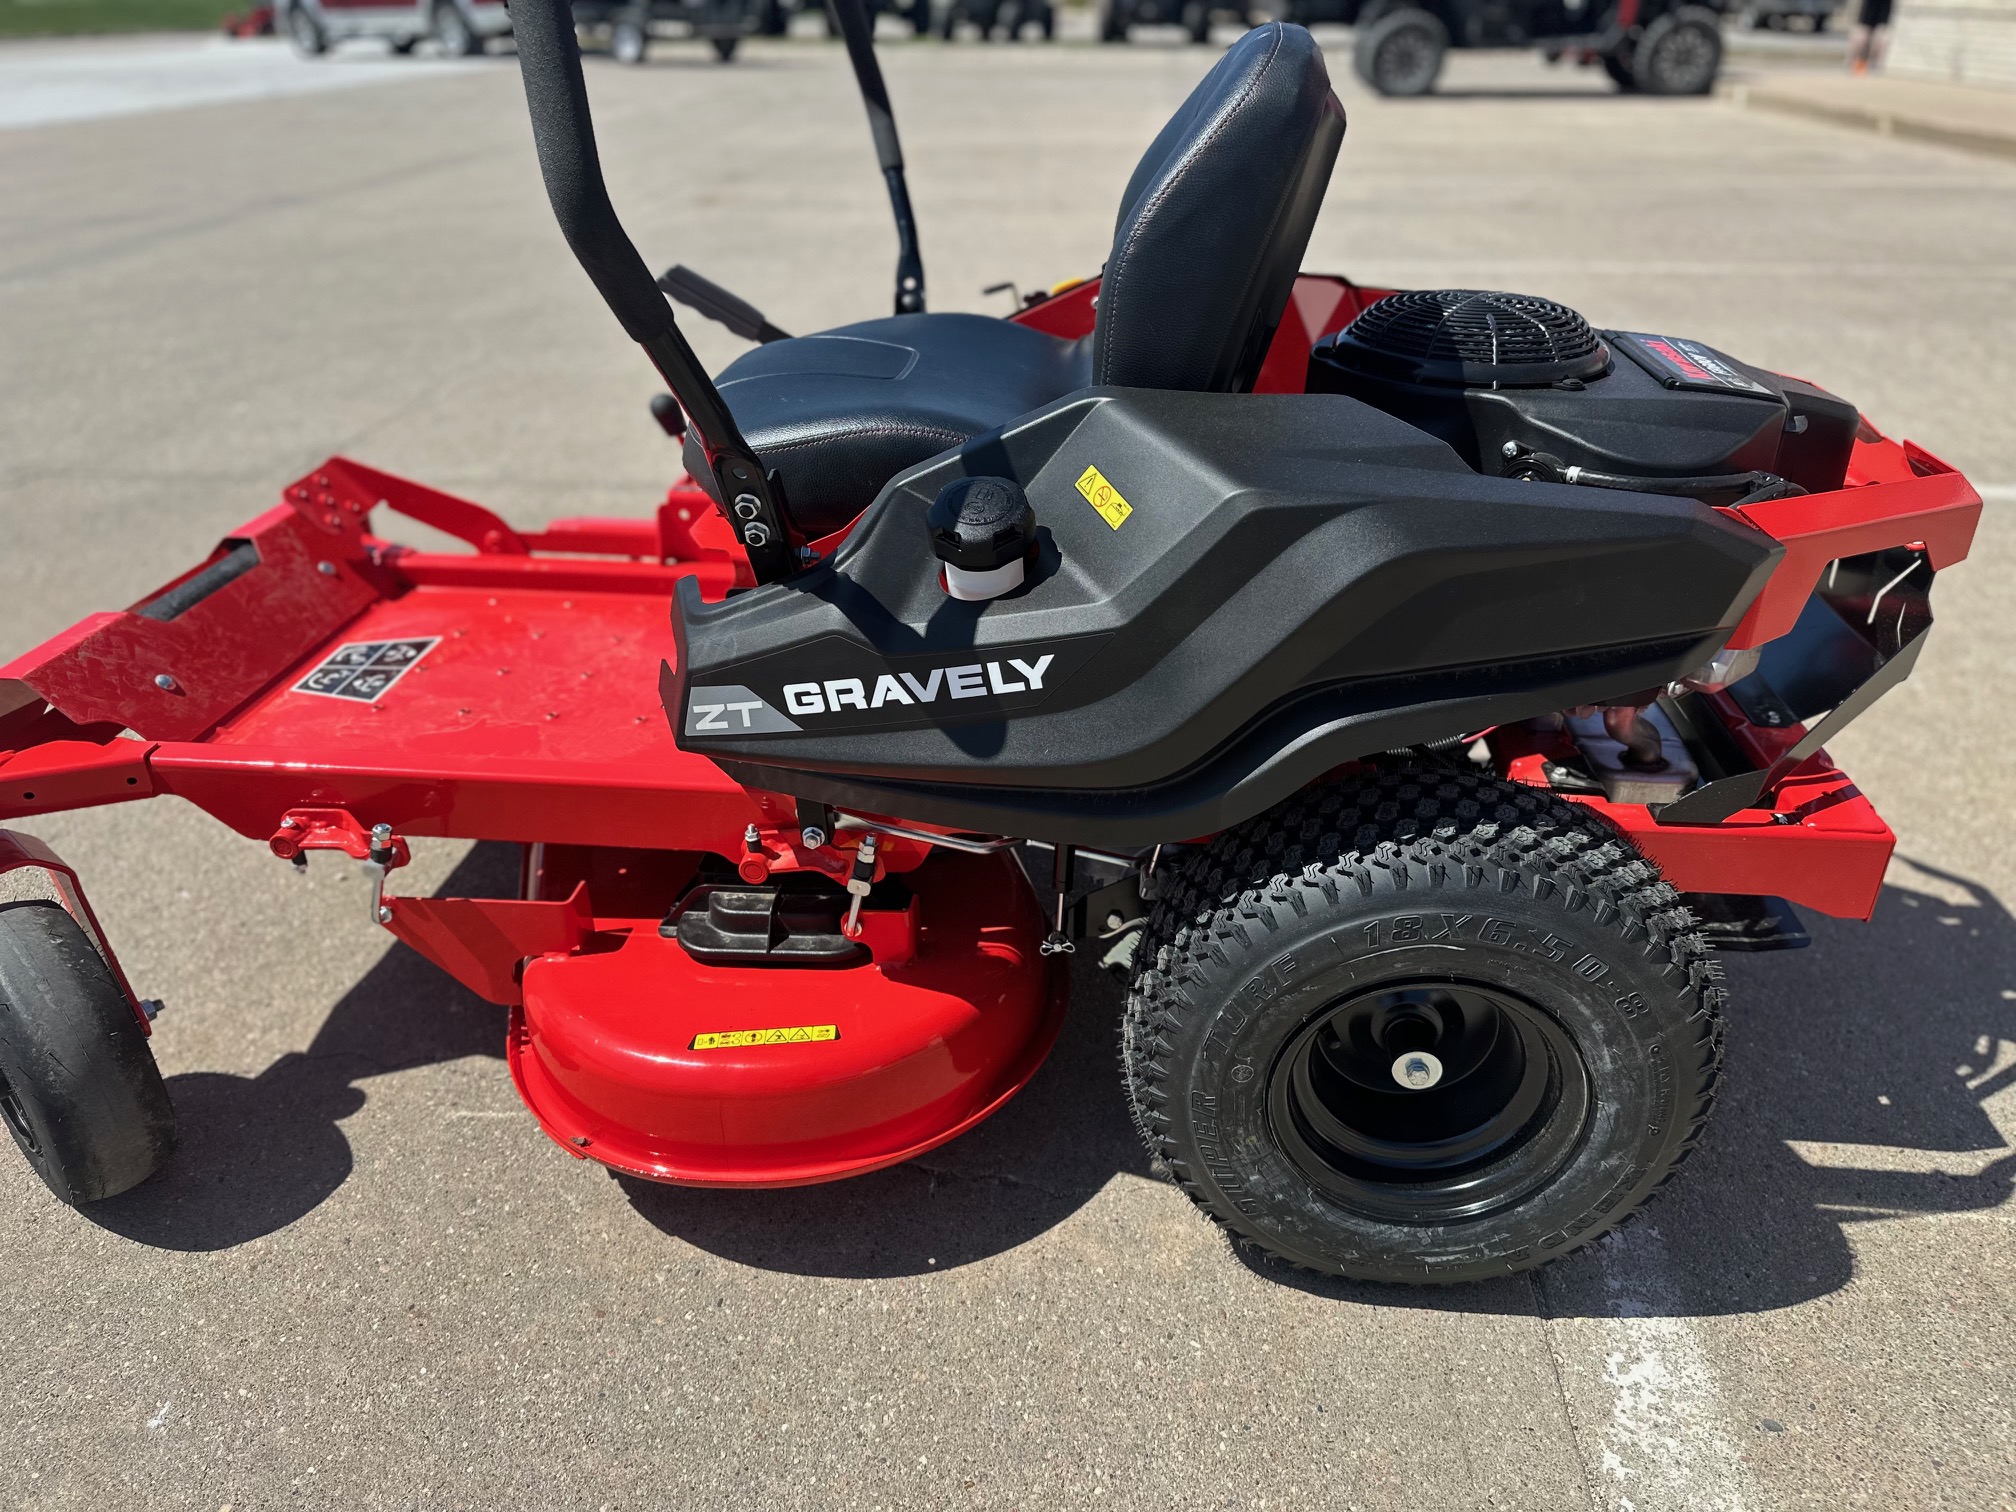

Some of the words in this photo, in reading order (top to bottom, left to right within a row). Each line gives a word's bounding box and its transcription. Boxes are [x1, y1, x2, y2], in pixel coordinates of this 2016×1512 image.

[692, 700, 764, 731] ZT
[782, 653, 1055, 715] GRAVELY
[1203, 952, 1298, 1058] TURF
[1500, 1163, 1649, 1263] KENDA
